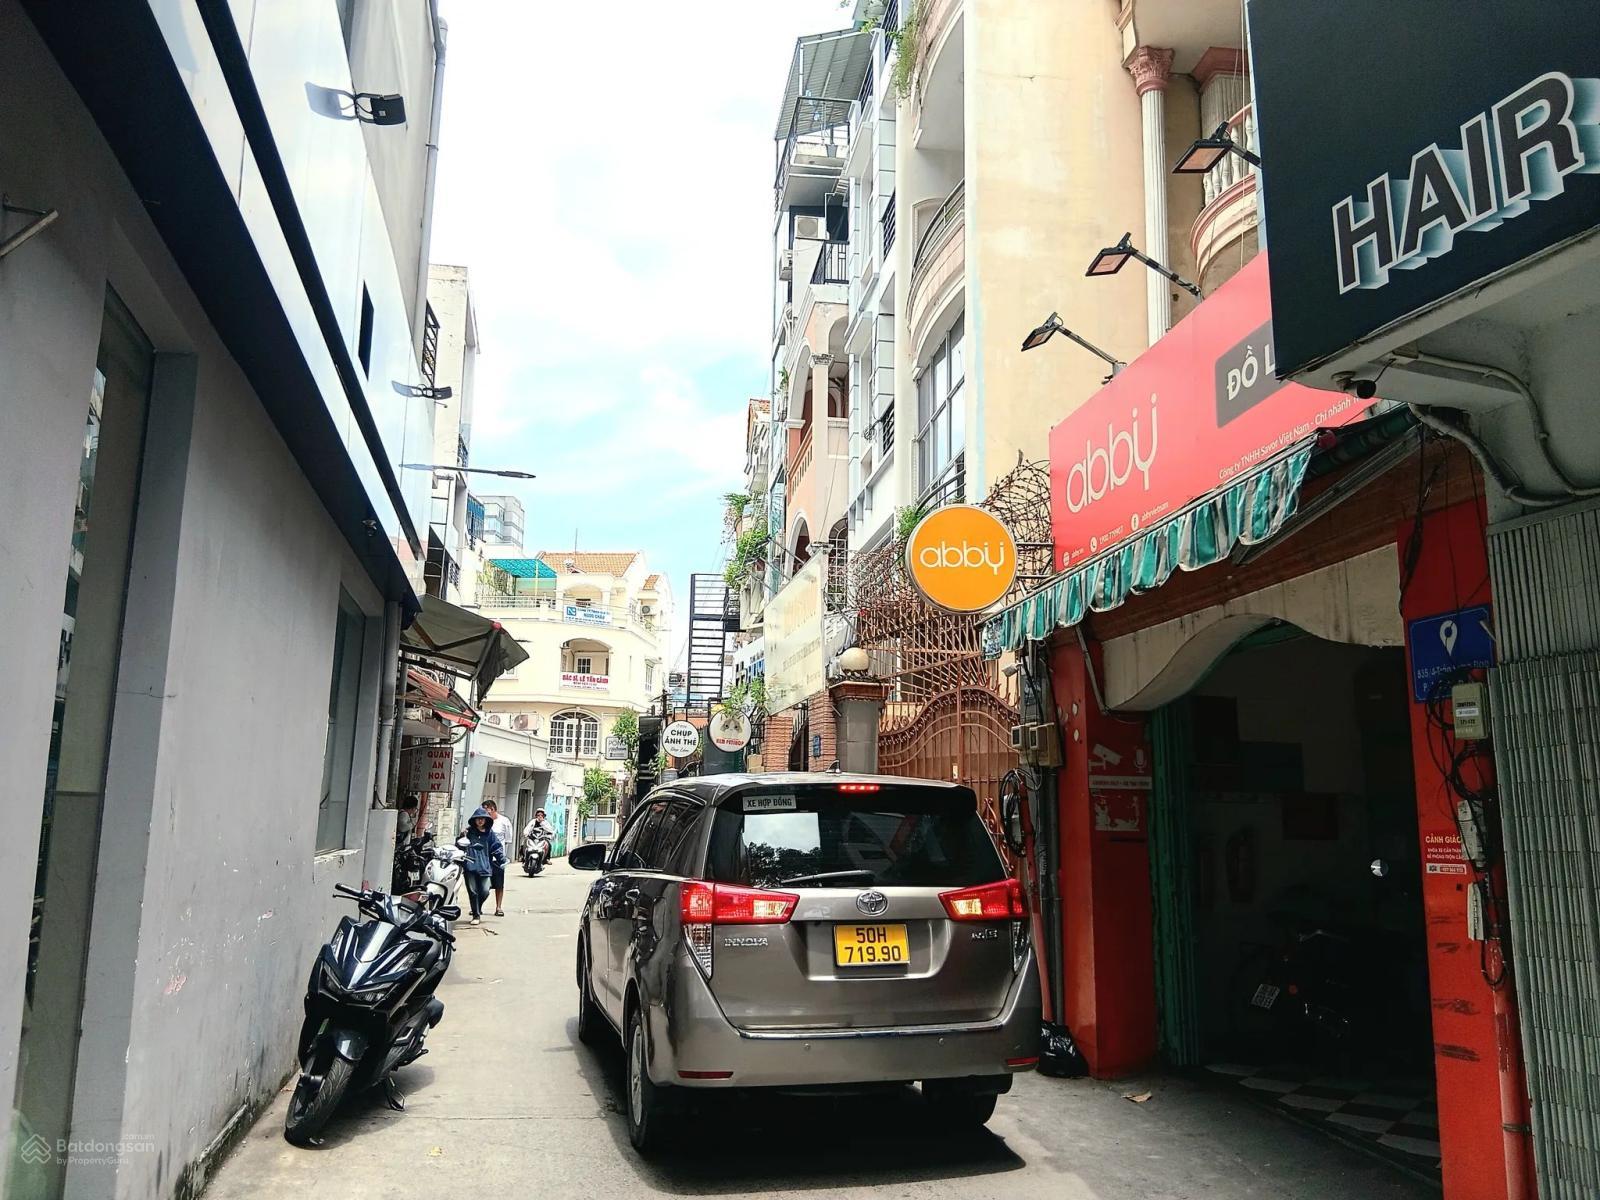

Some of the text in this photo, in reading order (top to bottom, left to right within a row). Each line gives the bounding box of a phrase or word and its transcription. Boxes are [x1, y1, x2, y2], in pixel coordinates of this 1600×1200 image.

[1332, 71, 1586, 295] HAIR
[1226, 344, 1275, 400] ĐỒ L
[1065, 393, 1158, 514] abby
[1219, 462, 1236, 479] Công
[1241, 449, 1262, 467] TNHH
[1315, 409, 1328, 425] Chi
[920, 540, 1005, 576] abby
[747, 799, 757, 807] XE
[1425, 832, 1444, 844] CẢNH
[724, 937, 769, 946] INNOVA
[855, 926, 887, 944] 50H
[844, 945, 902, 963] 719.90
